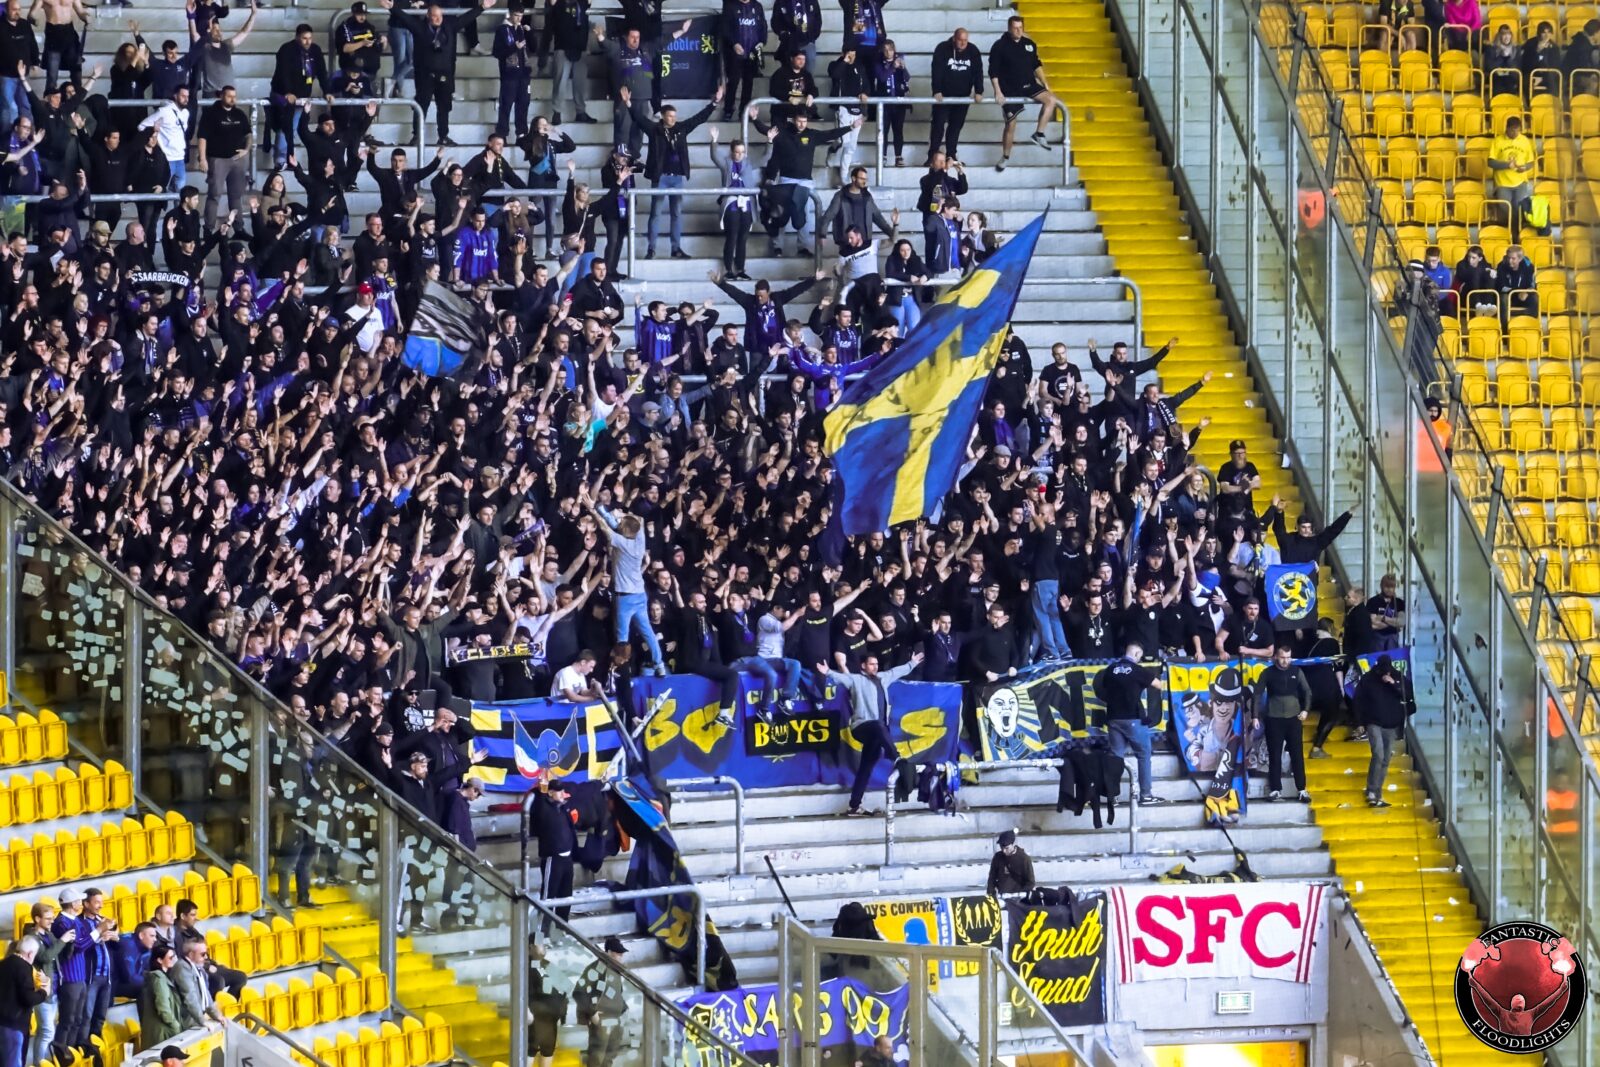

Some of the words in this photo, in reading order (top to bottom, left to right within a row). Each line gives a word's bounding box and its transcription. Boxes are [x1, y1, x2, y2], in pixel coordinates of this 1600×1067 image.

[138, 271, 190, 287] SAARBRÜCKEN
[1012, 899, 1104, 962] Youth
[1132, 894, 1301, 968] SFC
[842, 986, 890, 1039] 99
